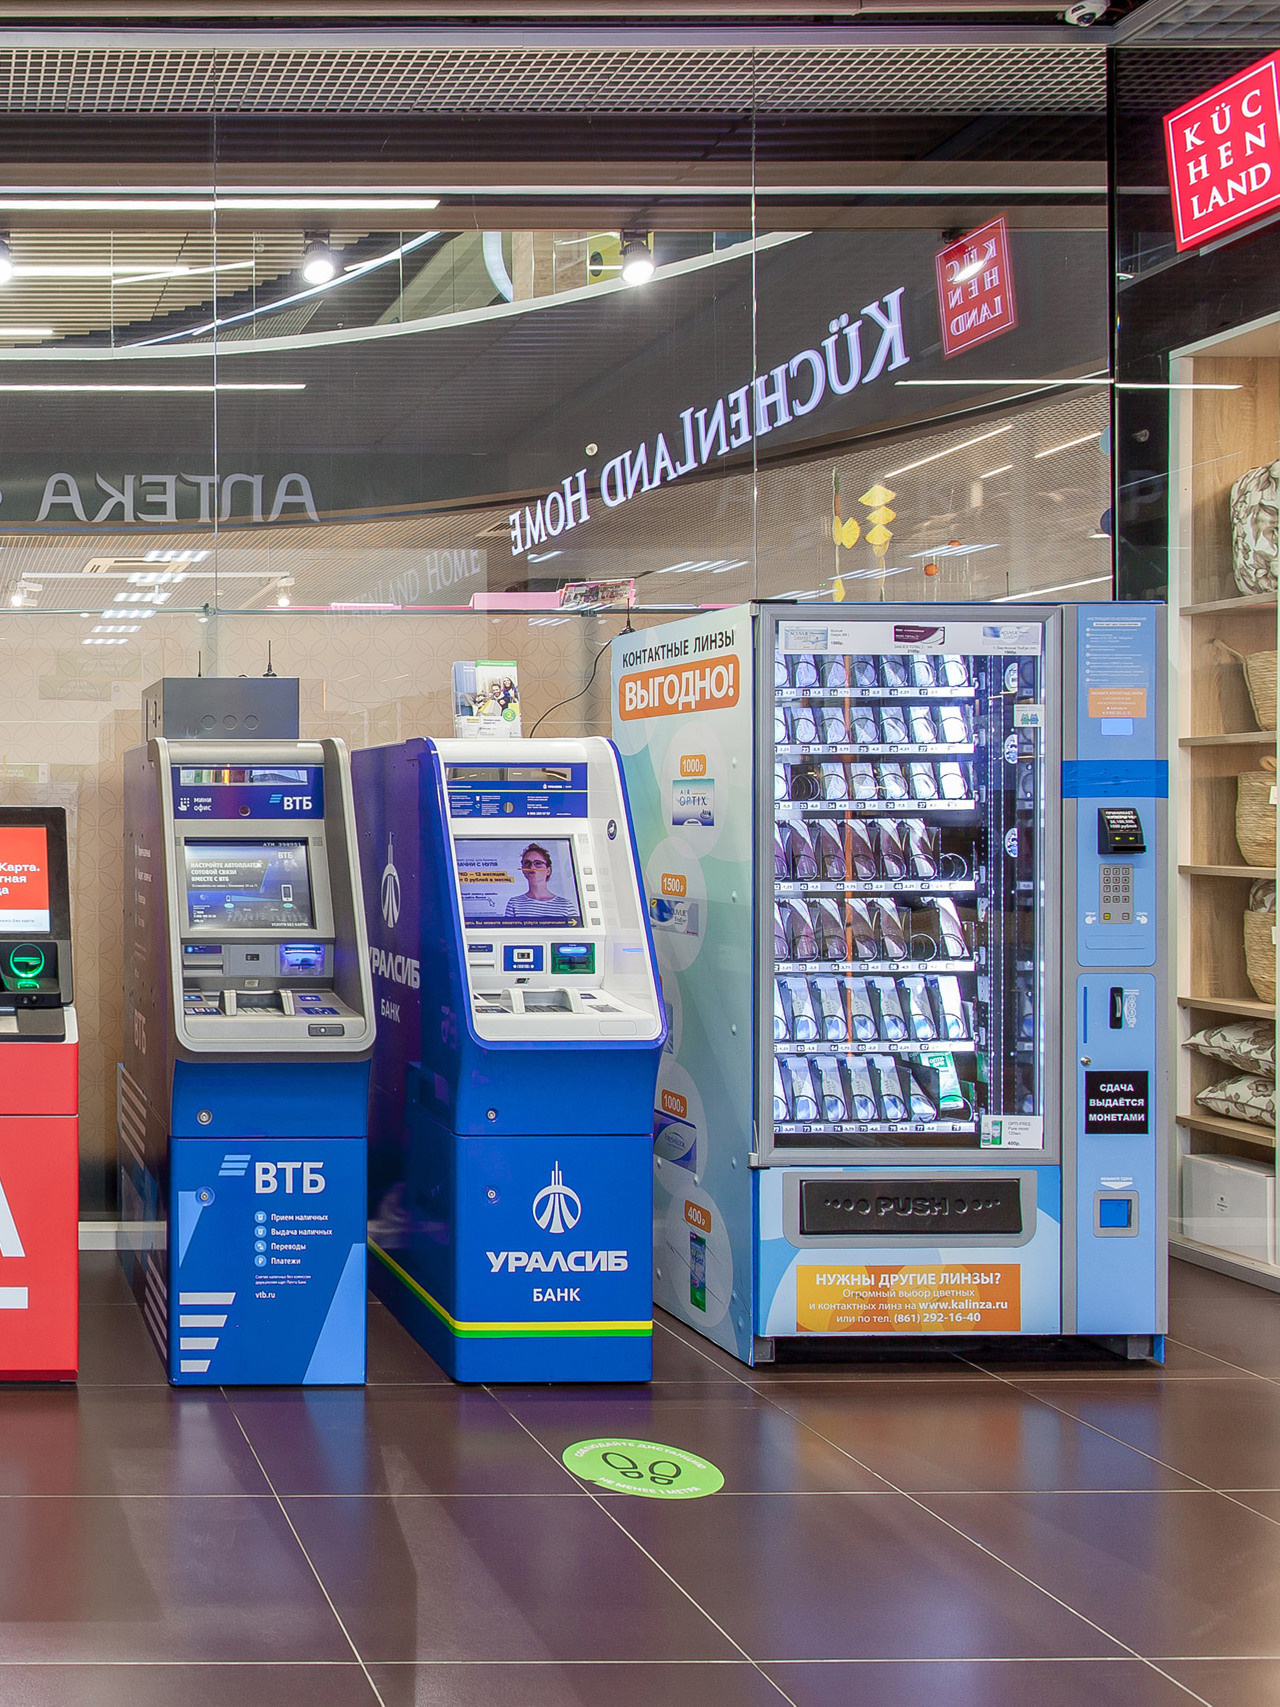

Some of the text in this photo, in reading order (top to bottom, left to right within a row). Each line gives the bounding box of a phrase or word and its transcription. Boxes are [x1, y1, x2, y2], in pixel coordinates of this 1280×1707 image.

[1190, 162, 1272, 220] LAND
[622, 629, 735, 668] КОНТАКТНЫЕ ЛИНЗЫ
[624, 663, 735, 711] ВЫГОДНО!
[283, 796, 313, 810] ВТБ
[679, 796, 708, 806] OPTIX
[381, 998, 400, 1023] БАНК
[1099, 1084, 1134, 1093] СДАЧА
[1089, 1097, 1145, 1107] ВЫДАЁТСЯ
[1088, 1114, 1145, 1122] МОНЕТАМИ
[255, 1161, 326, 1194] ВТБ
[877, 1197, 950, 1217] PUSH
[271, 1214, 293, 1222] Прием
[271, 1228, 297, 1236] Выдача
[271, 1242, 306, 1251] Переводы
[485, 1251, 628, 1272] УРАЛСИБ
[815, 1272, 1001, 1288] НУЖНЫ ДРУГИЕ ЛИНЗЫ?
[255, 1291, 276, 1299] vtb.ru
[532, 1288, 581, 1301] БАНК
[842, 1288, 975, 1299] Огромный выбор цветных
[904, 1302, 917, 1310] на
[919, 1299, 1008, 1310] www.kalinza.ru
[836, 1312, 981, 1324] или по тел. (861) 292-16-40
